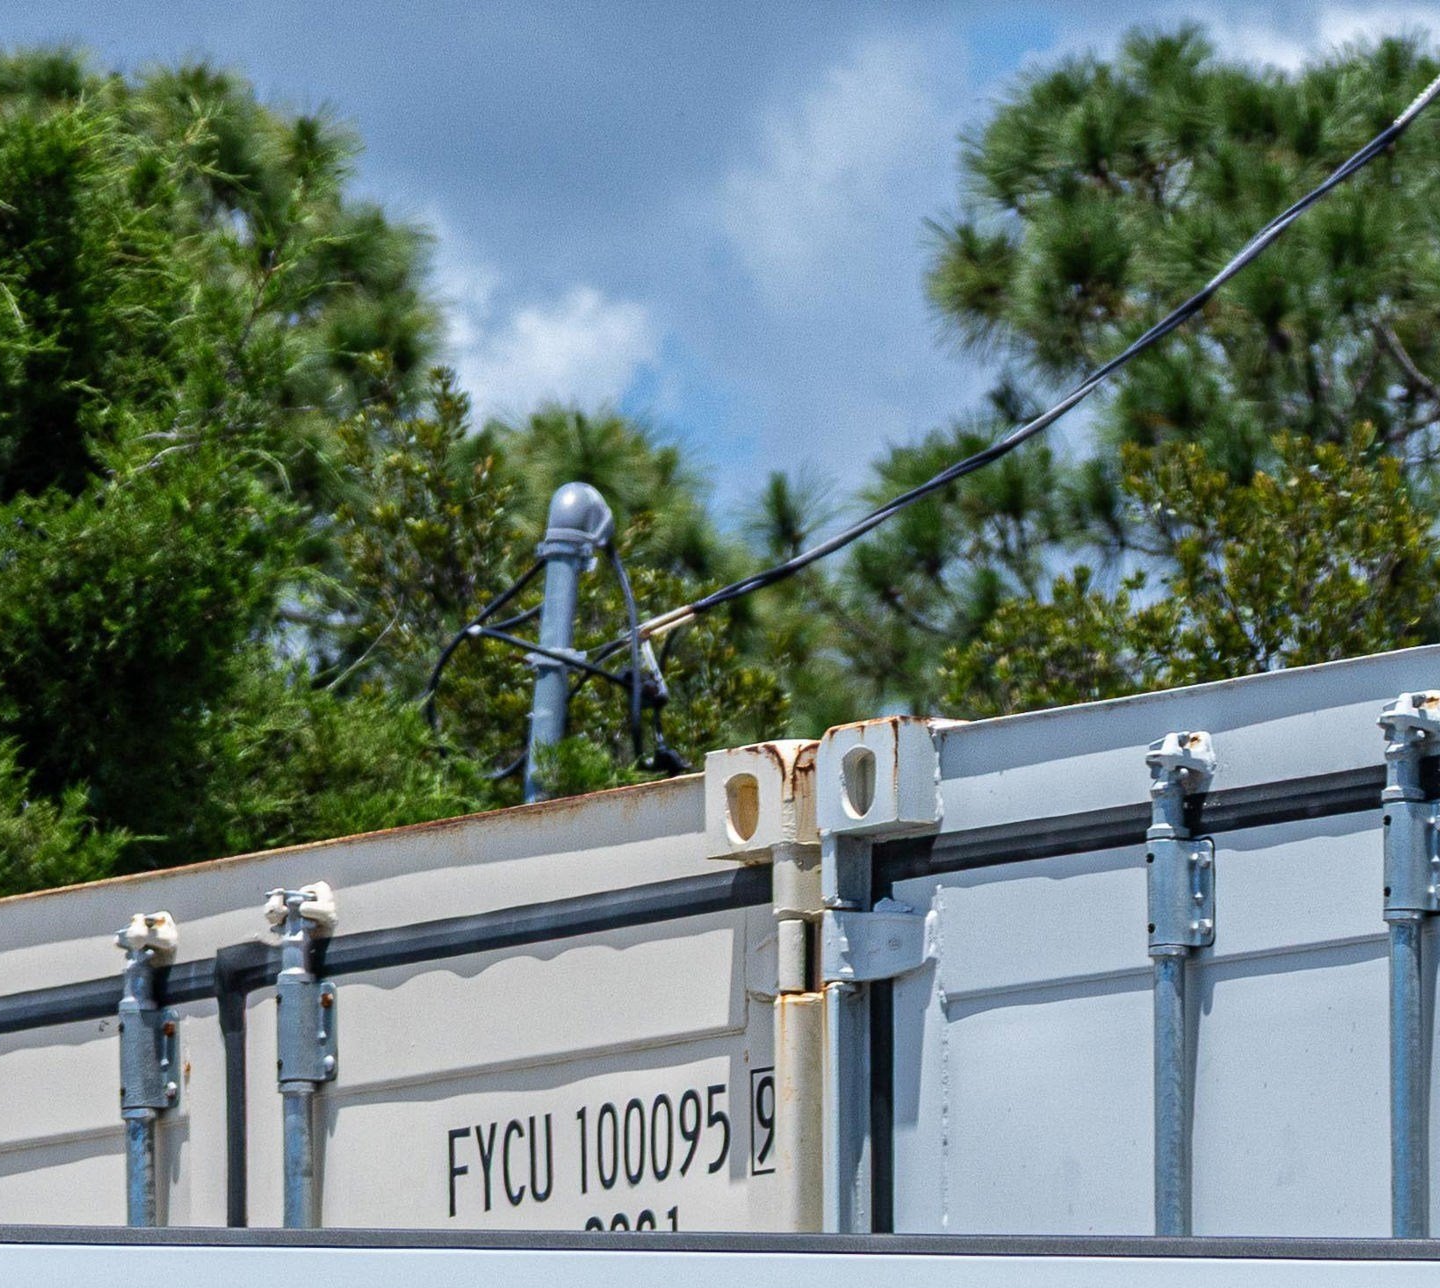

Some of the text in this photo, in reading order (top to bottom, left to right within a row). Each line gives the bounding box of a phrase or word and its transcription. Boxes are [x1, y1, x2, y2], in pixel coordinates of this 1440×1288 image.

[448, 1075, 775, 1217] FYCU 100095 9
